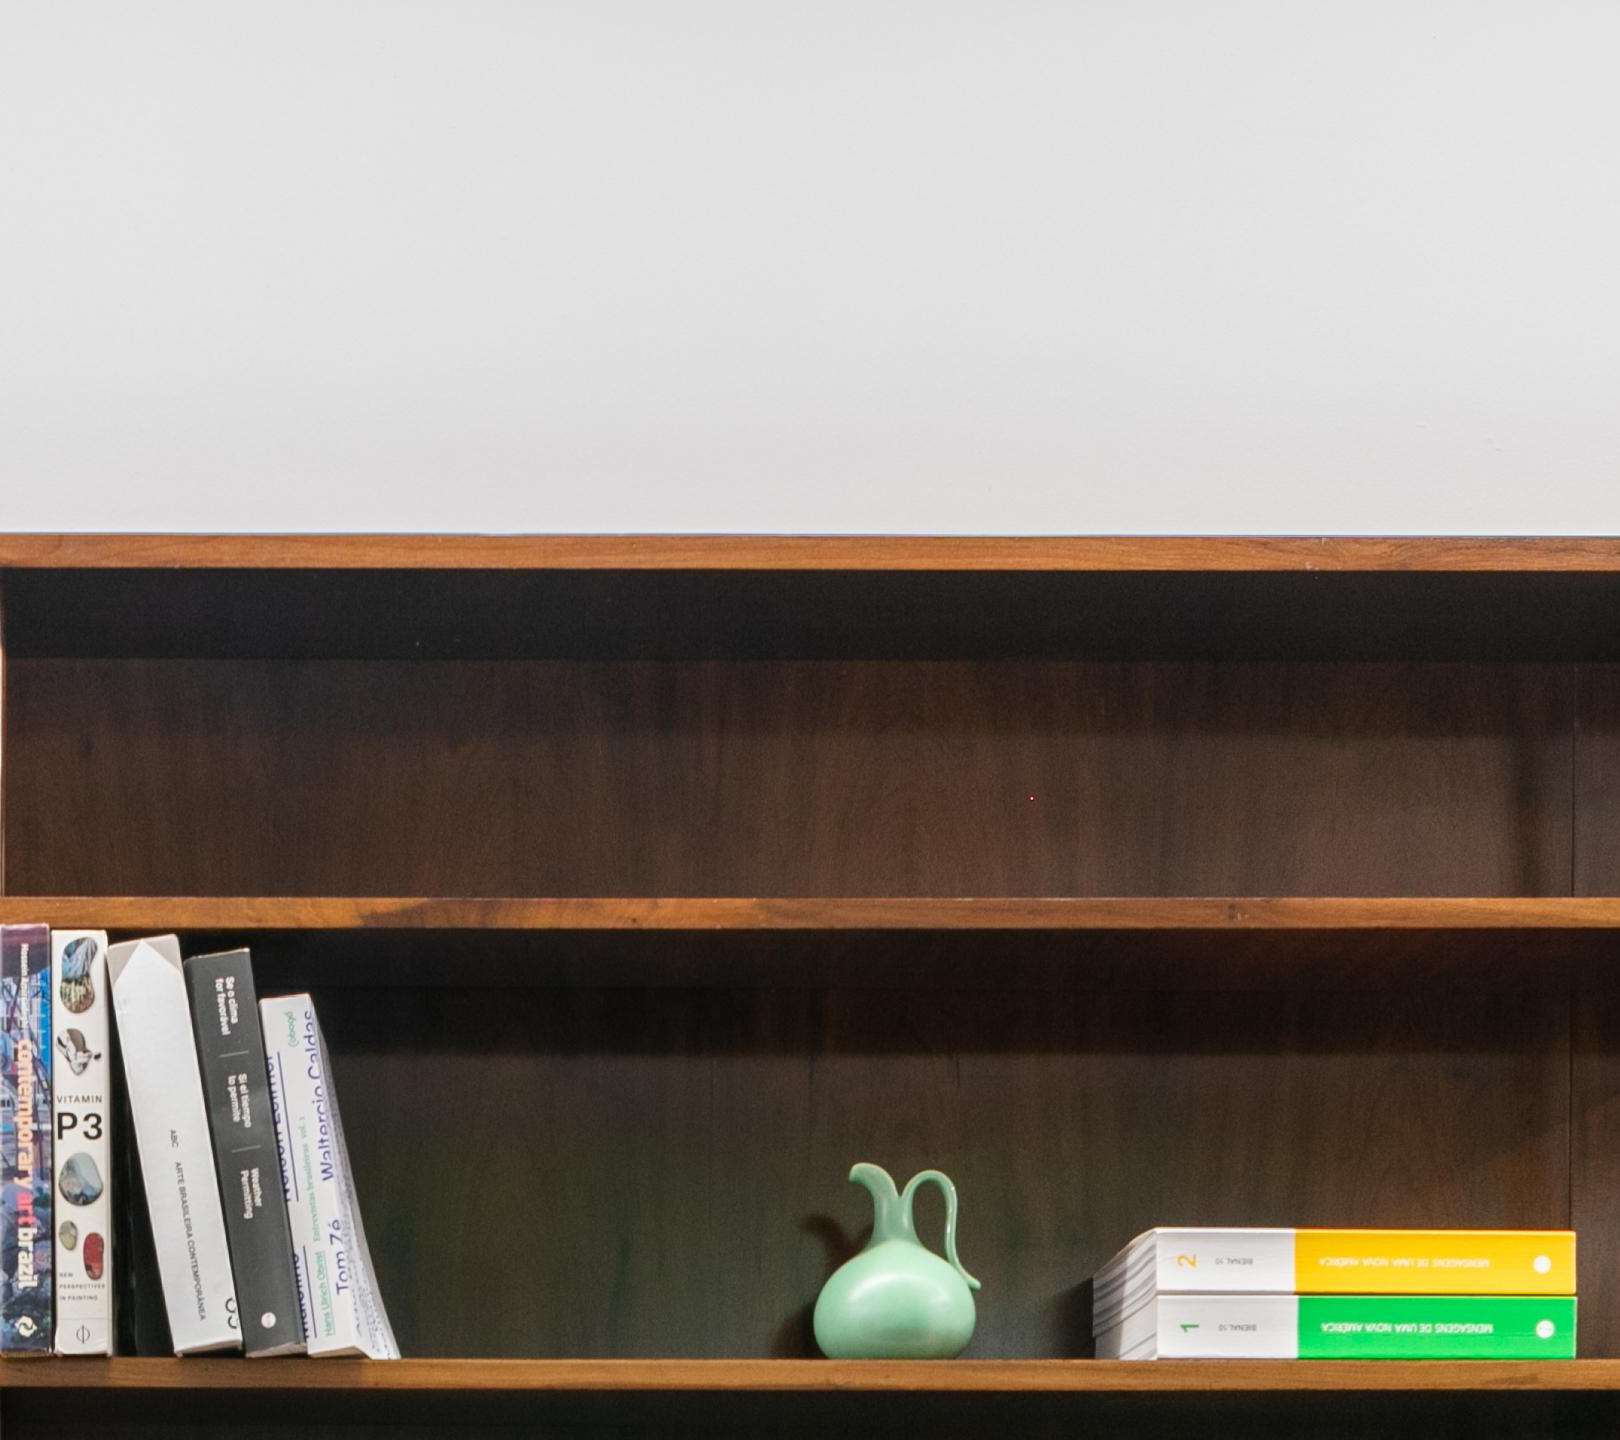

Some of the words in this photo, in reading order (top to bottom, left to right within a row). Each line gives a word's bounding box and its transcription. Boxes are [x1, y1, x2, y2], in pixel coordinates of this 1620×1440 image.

[215, 978, 225, 992] for
[224, 976, 235, 990] Se
[226, 990, 234, 998] o
[216, 993, 232, 1036] favorável
[228, 999, 240, 1024] clima
[303, 1010, 324, 1081] Caldas
[237, 1073, 247, 1084] Si
[239, 1084, 249, 1095] el
[56, 1095, 103, 1104] VITAMIN
[227, 1085, 242, 1123] permite
[240, 1095, 253, 1129] tiempo
[14, 1039, 36, 1188] contemporary
[57, 1112, 103, 1141] P3
[170, 1129, 180, 1149] ABC
[312, 1086, 335, 1181] Waltercio
[174, 1161, 185, 1185] ARTE
[300, 1143, 314, 1190] brasileiras
[240, 1169, 255, 1220] Permitting
[250, 1167, 262, 1207] Weather
[18, 1191, 36, 1226] art
[178, 1186, 194, 1239] BRASILEIRA
[308, 1191, 321, 1241] Entrevistas
[326, 1219, 343, 1246] Zé
[17, 1226, 38, 1290] brazil
[314, 1250, 328, 1281] Obrist
[1176, 1254, 1198, 1269] 2
[186, 1239, 208, 1321] CONTEMPORÂNEA
[332, 1252, 350, 1295] Tom
[317, 1282, 332, 1309] Ulrich
[320, 1312, 335, 1336] Hans
[1180, 1323, 1200, 1333] 1
[1229, 1324, 1257, 1332] BIENAL
[1320, 1322, 1364, 1334] AMÉRICA
[1364, 1322, 1392, 1333] NOVA
[1394, 1323, 1418, 1333] UMA
[1419, 1323, 1433, 1333] DE
[1435, 1323, 1494, 1334] MENSAGENS
